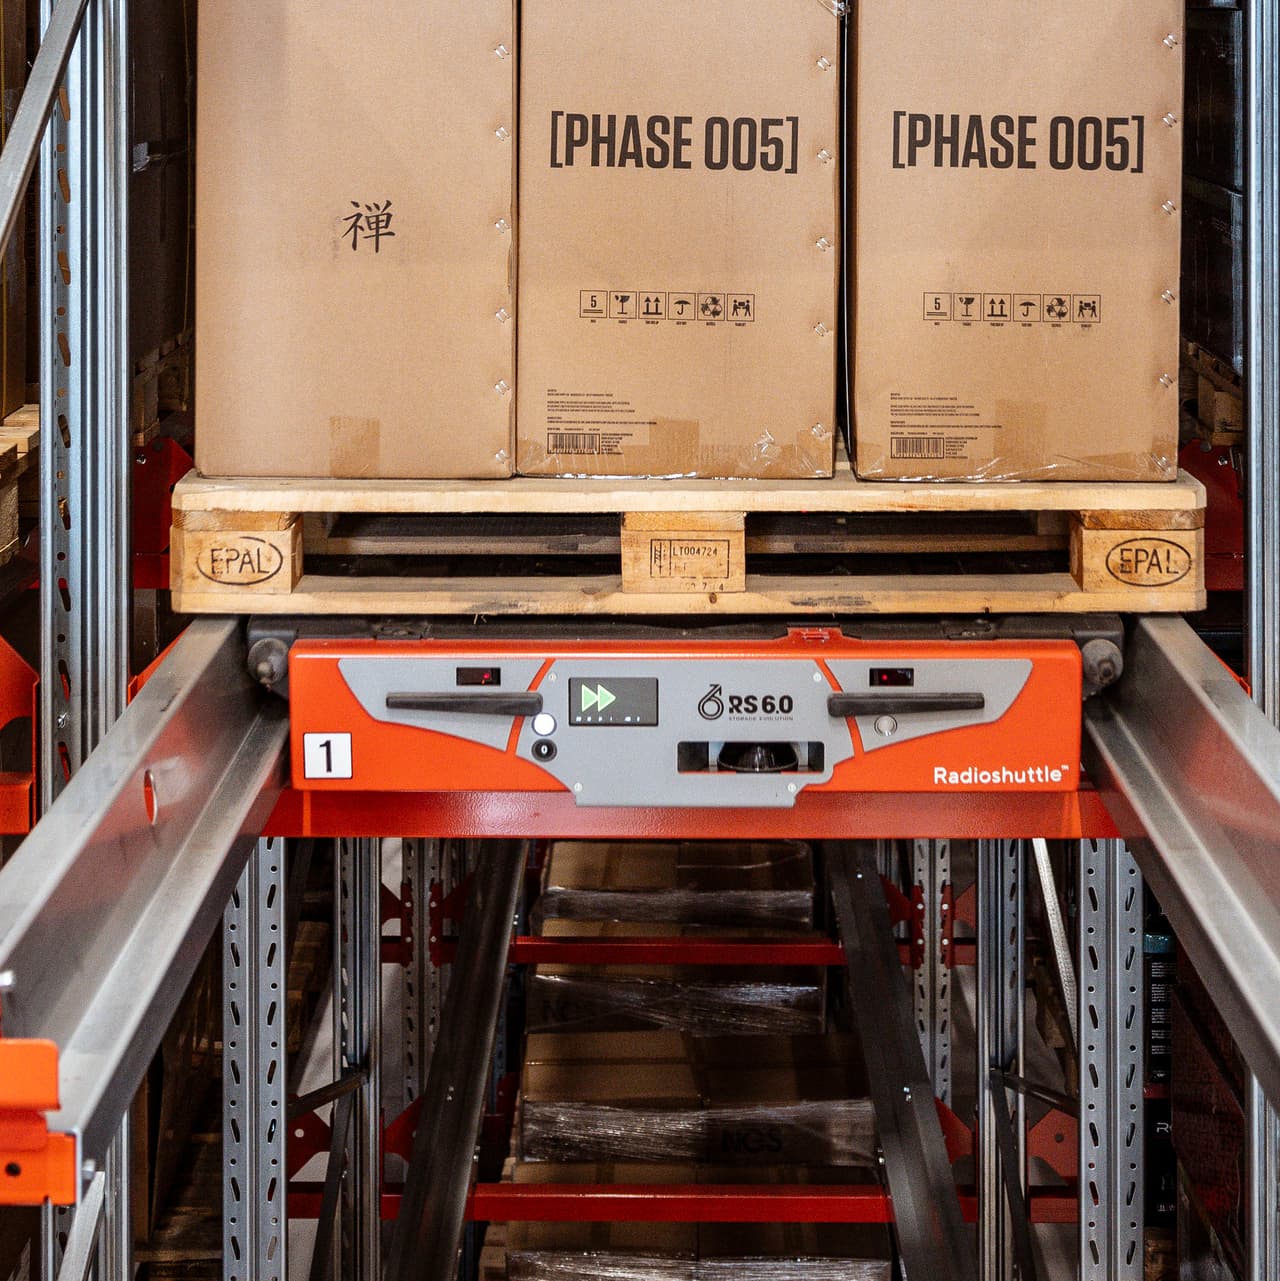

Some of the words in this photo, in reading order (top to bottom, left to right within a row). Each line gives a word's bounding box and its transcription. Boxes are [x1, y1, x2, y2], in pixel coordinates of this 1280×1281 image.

[550, 110, 693, 170] [PHASE
[704, 116, 799, 175] 005]
[892, 110, 1038, 170] [PHASE
[1049, 115, 1145, 174] 005]
[342, 199, 396, 254] 禅
[590, 295, 597, 309] 5
[934, 297, 941, 311] 5
[210, 547, 269, 577] EPAL
[673, 546, 718, 557] LT004724
[1118, 547, 1179, 577] EPAL
[729, 695, 758, 714] RS
[762, 695, 794, 714] 6.0
[318, 740, 334, 772] 1
